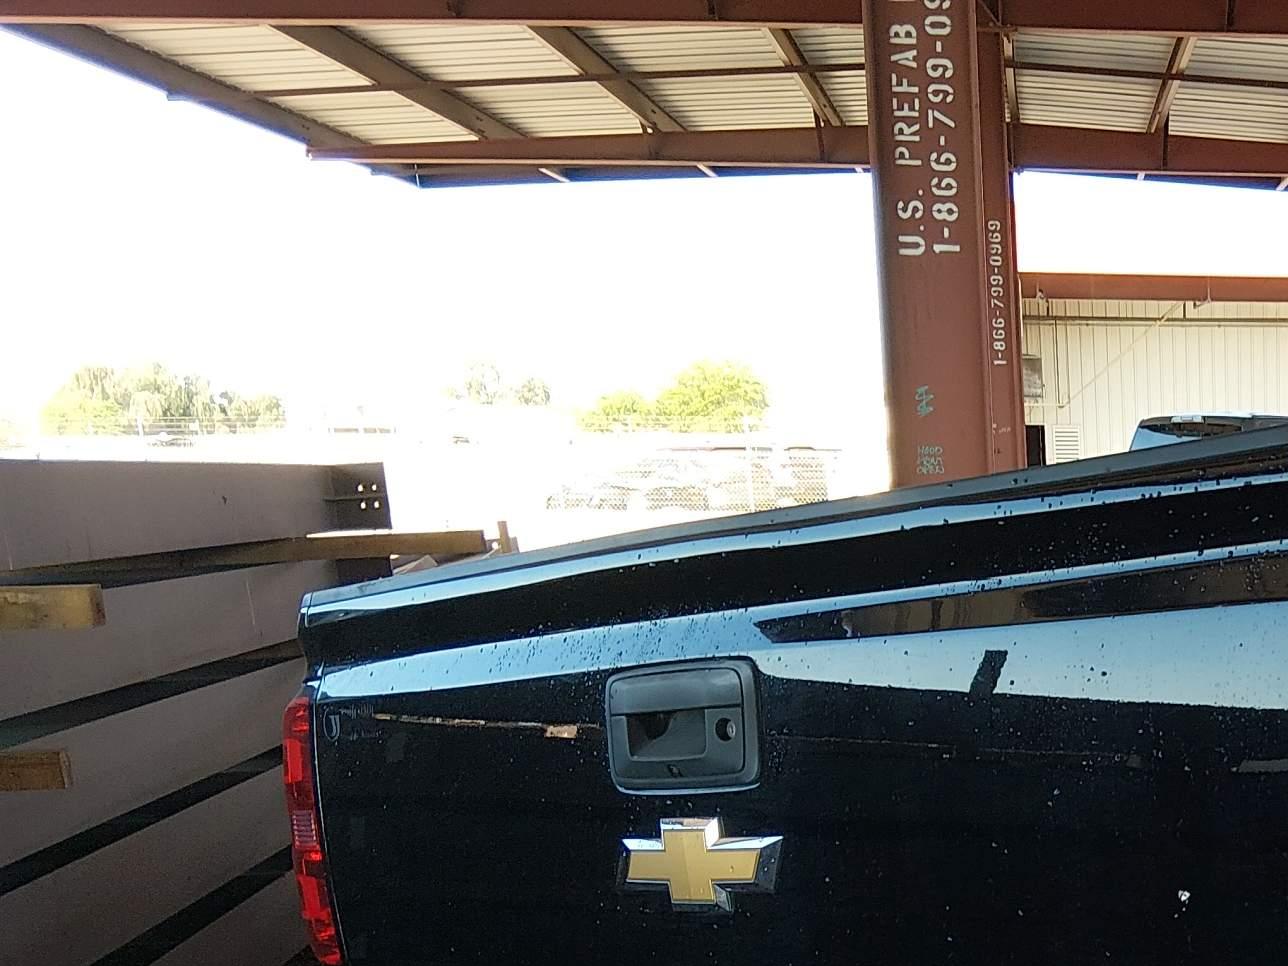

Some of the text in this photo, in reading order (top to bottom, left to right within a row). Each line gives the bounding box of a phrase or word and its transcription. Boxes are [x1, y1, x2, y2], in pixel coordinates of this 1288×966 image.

[889, 24, 926, 256] U.S. PREFAB
[987, 219, 1008, 367] 1-866-799-0969
